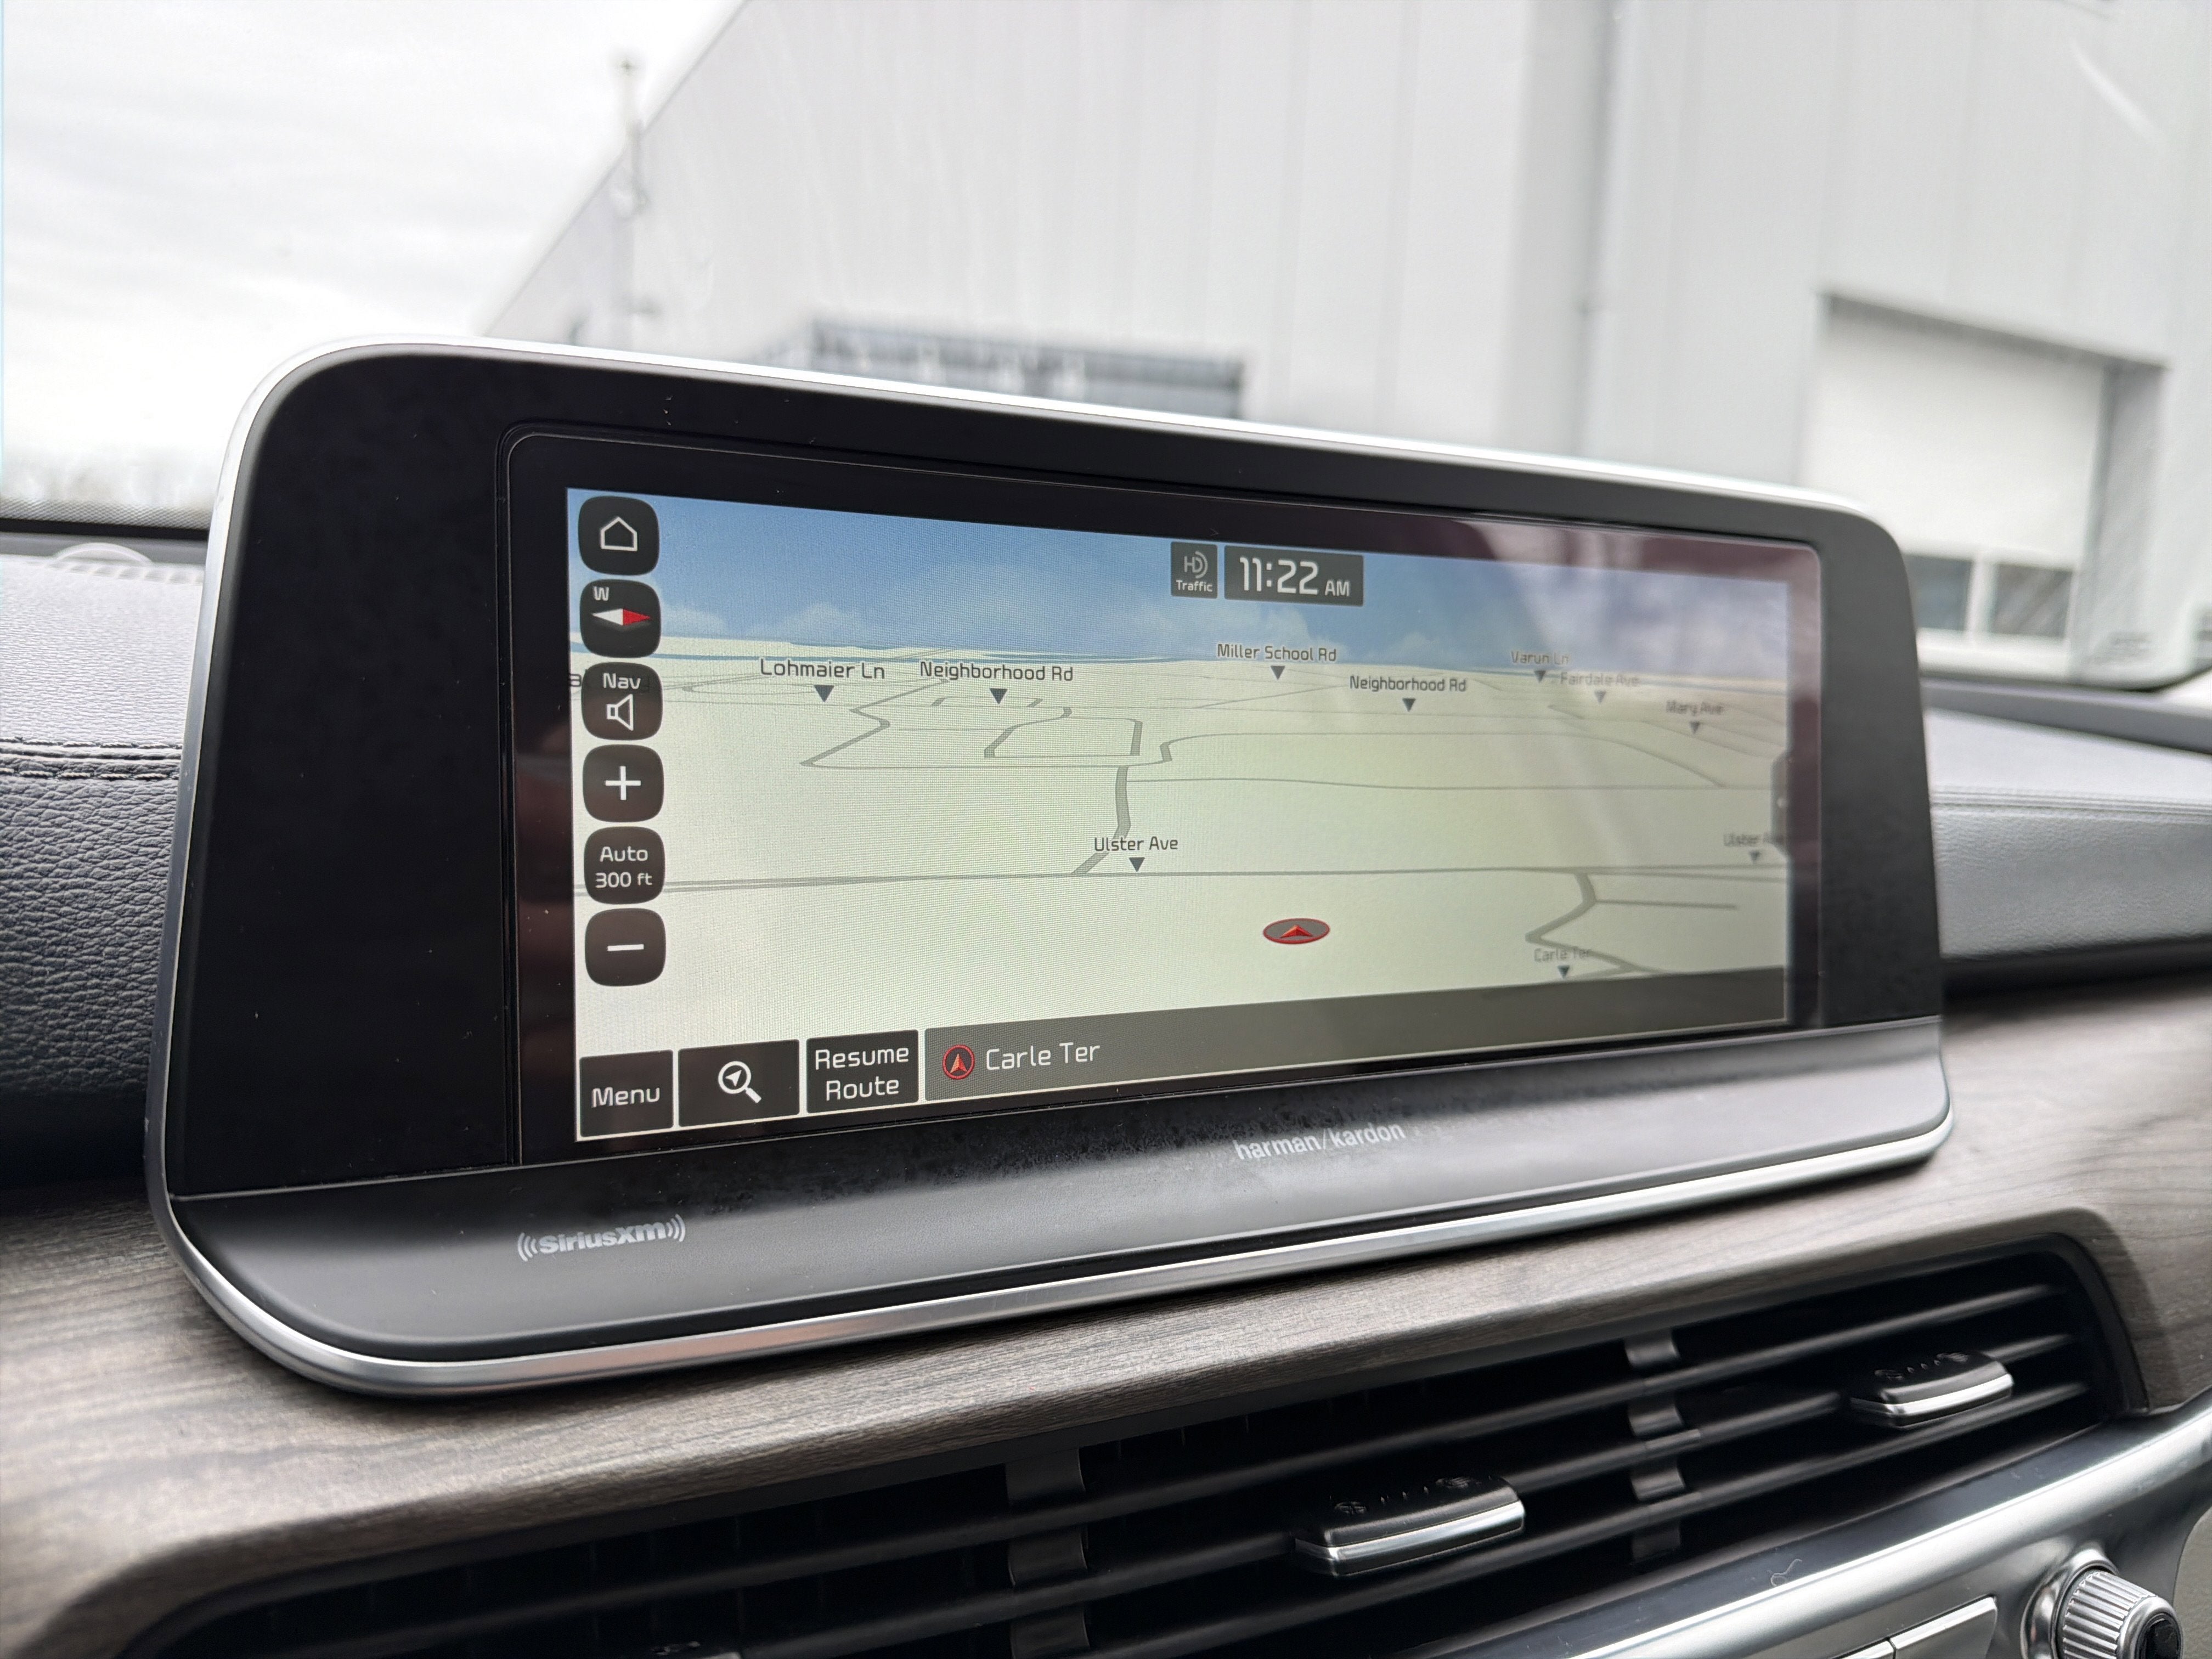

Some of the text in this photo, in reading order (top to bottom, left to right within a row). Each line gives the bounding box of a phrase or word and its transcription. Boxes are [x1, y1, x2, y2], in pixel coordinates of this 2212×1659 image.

[1239, 556, 1350, 597] 11:22 AM
[593, 586, 610, 601] W
[1176, 580, 1213, 592] Traffic
[1216, 643, 1337, 662] Miller School Rd
[1511, 651, 1549, 664] Varun
[760, 659, 885, 679] Lohmaier Ln
[920, 661, 1074, 681] Neighborhood Rd
[603, 673, 641, 689] Nav
[1349, 675, 1467, 693] Neighborhood Rd
[600, 845, 648, 862] Auto
[1093, 837, 1179, 852] Ulster Ave
[595, 871, 653, 889] 300 ft
[815, 1046, 910, 1070] Resume
[985, 1042, 1101, 1071] Carle Ter
[825, 1075, 900, 1101] Route
[591, 1087, 661, 1108] Menu
